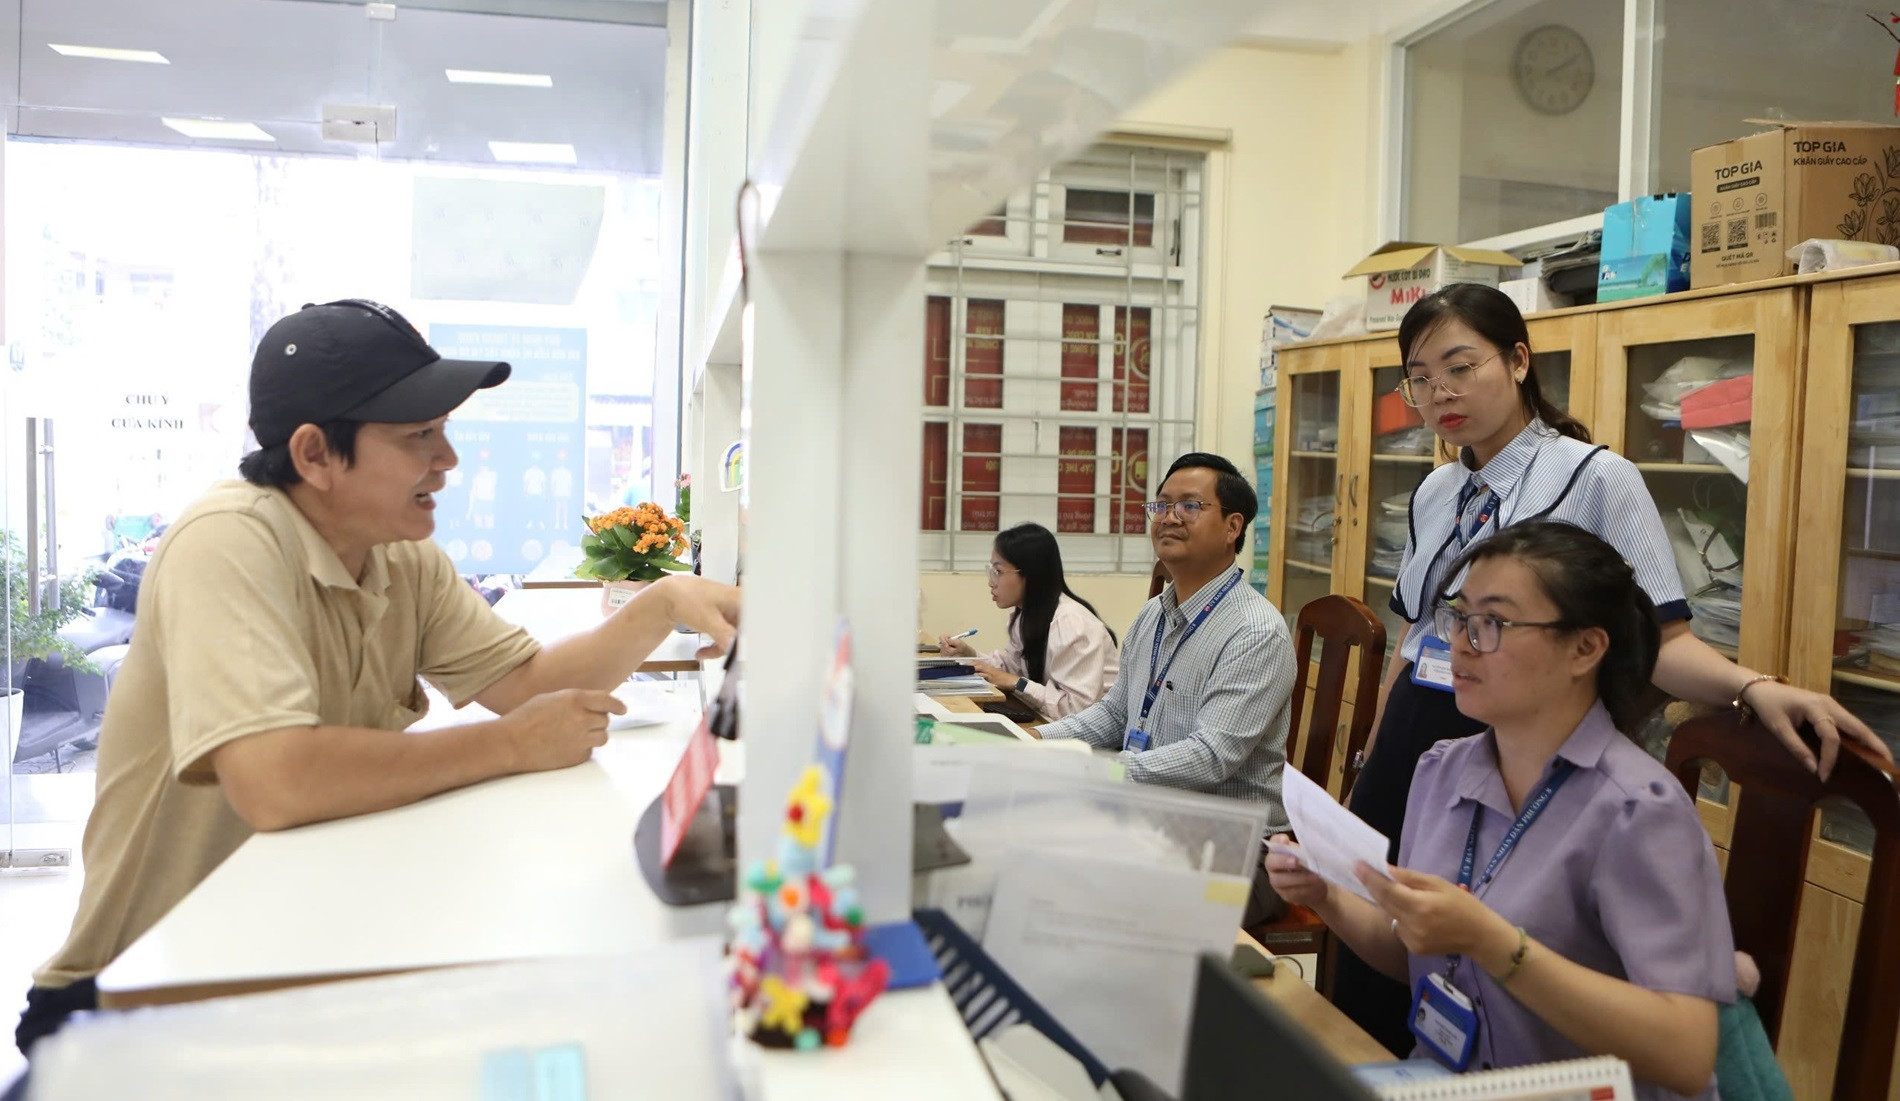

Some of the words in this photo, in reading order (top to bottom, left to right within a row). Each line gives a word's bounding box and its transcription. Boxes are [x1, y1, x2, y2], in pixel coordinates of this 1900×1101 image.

[1793, 141, 1820, 153] TOP
[1823, 141, 1846, 153] GIA
[1836, 157, 1851, 166] CAO
[1715, 165, 1739, 180] TOP
[1741, 160, 1763, 175] GIA
[1510, 822, 1524, 840] DÂN
